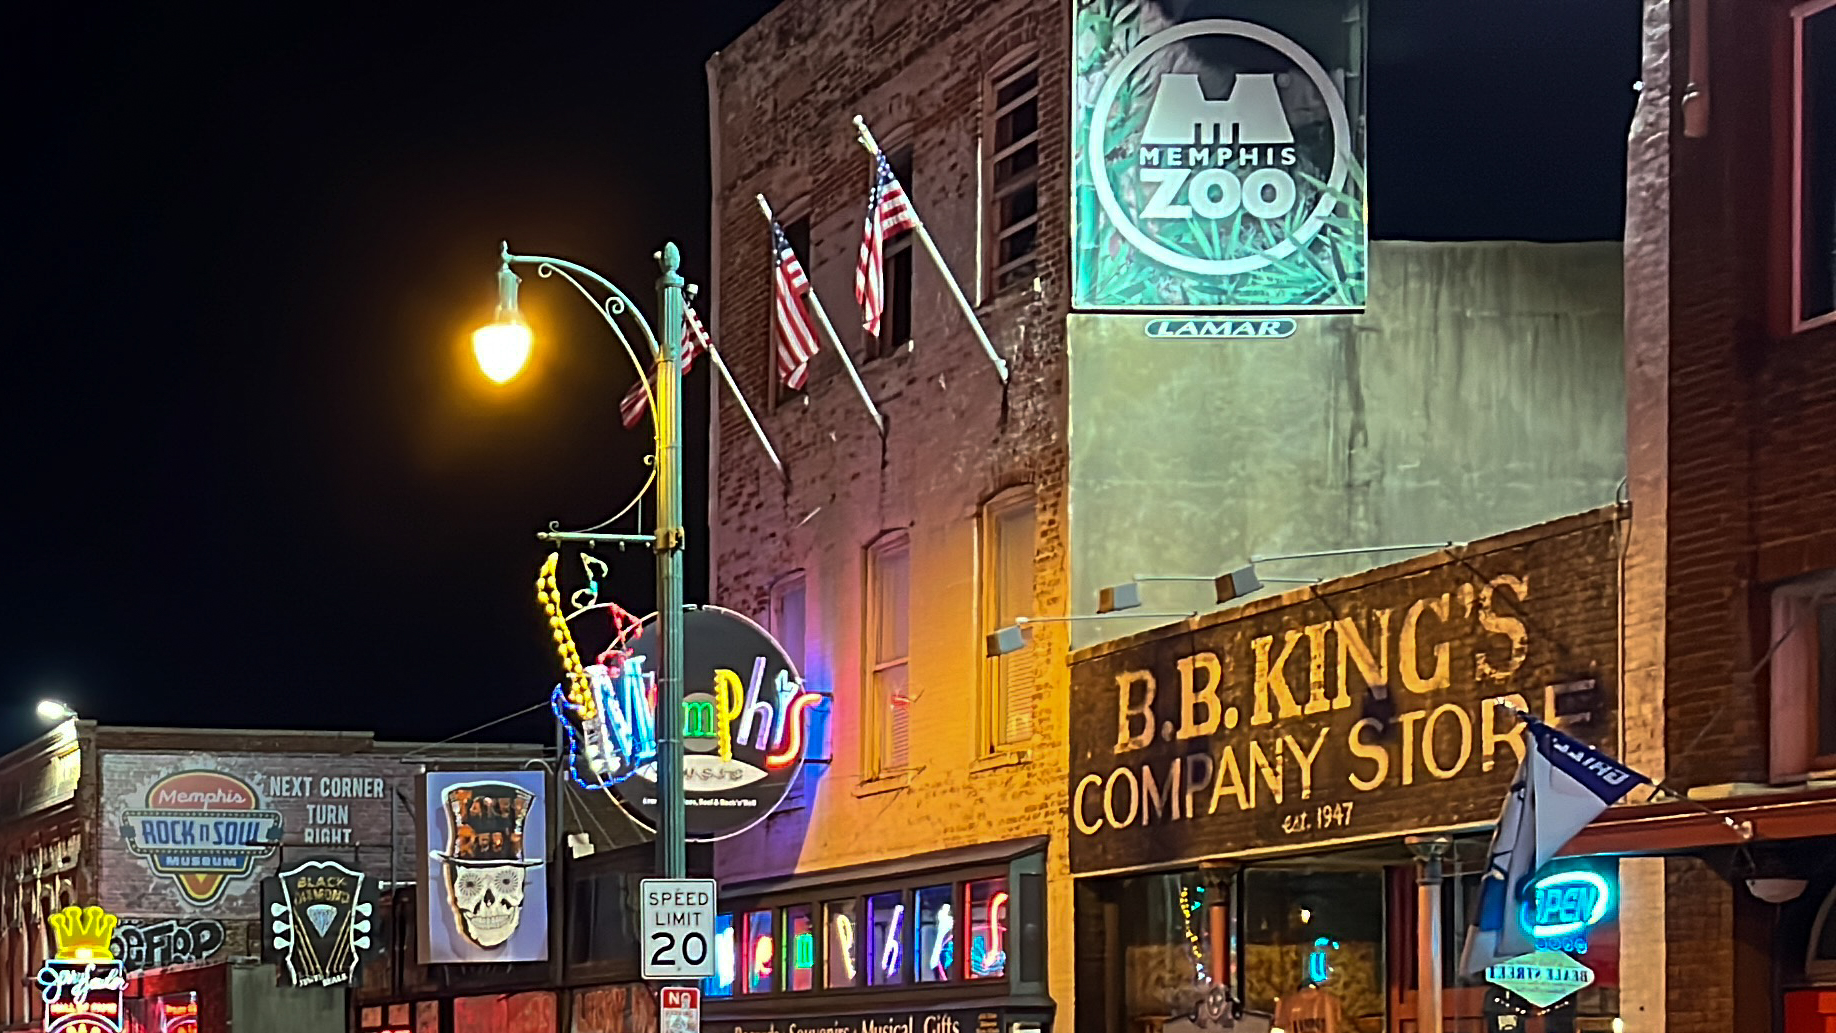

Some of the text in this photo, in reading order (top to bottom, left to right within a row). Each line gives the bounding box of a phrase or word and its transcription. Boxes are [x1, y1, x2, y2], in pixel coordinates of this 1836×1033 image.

[1139, 147, 1296, 166] MEMPHIS
[1139, 168, 1296, 219] ZOO
[1157, 320, 1281, 336] LAMAR
[1113, 574, 1530, 755] B.B. KING'S
[585, 655, 824, 769] Mmphis
[1074, 679, 1597, 836] COMPANY STORE
[270, 777, 384, 798] NEXT CORNER
[158, 788, 246, 810] Memphis
[306, 804, 349, 825] TURN
[1281, 802, 1354, 834] est. 1947
[142, 820, 196, 846] ROCK
[213, 819, 262, 846] SOUL
[304, 828, 352, 844] RIGHT
[166, 856, 238, 868] MUSEUM
[297, 876, 347, 889] BLACK
[649, 891, 709, 906] SPEED
[655, 911, 701, 926] LIMIT
[651, 931, 708, 966] 20
